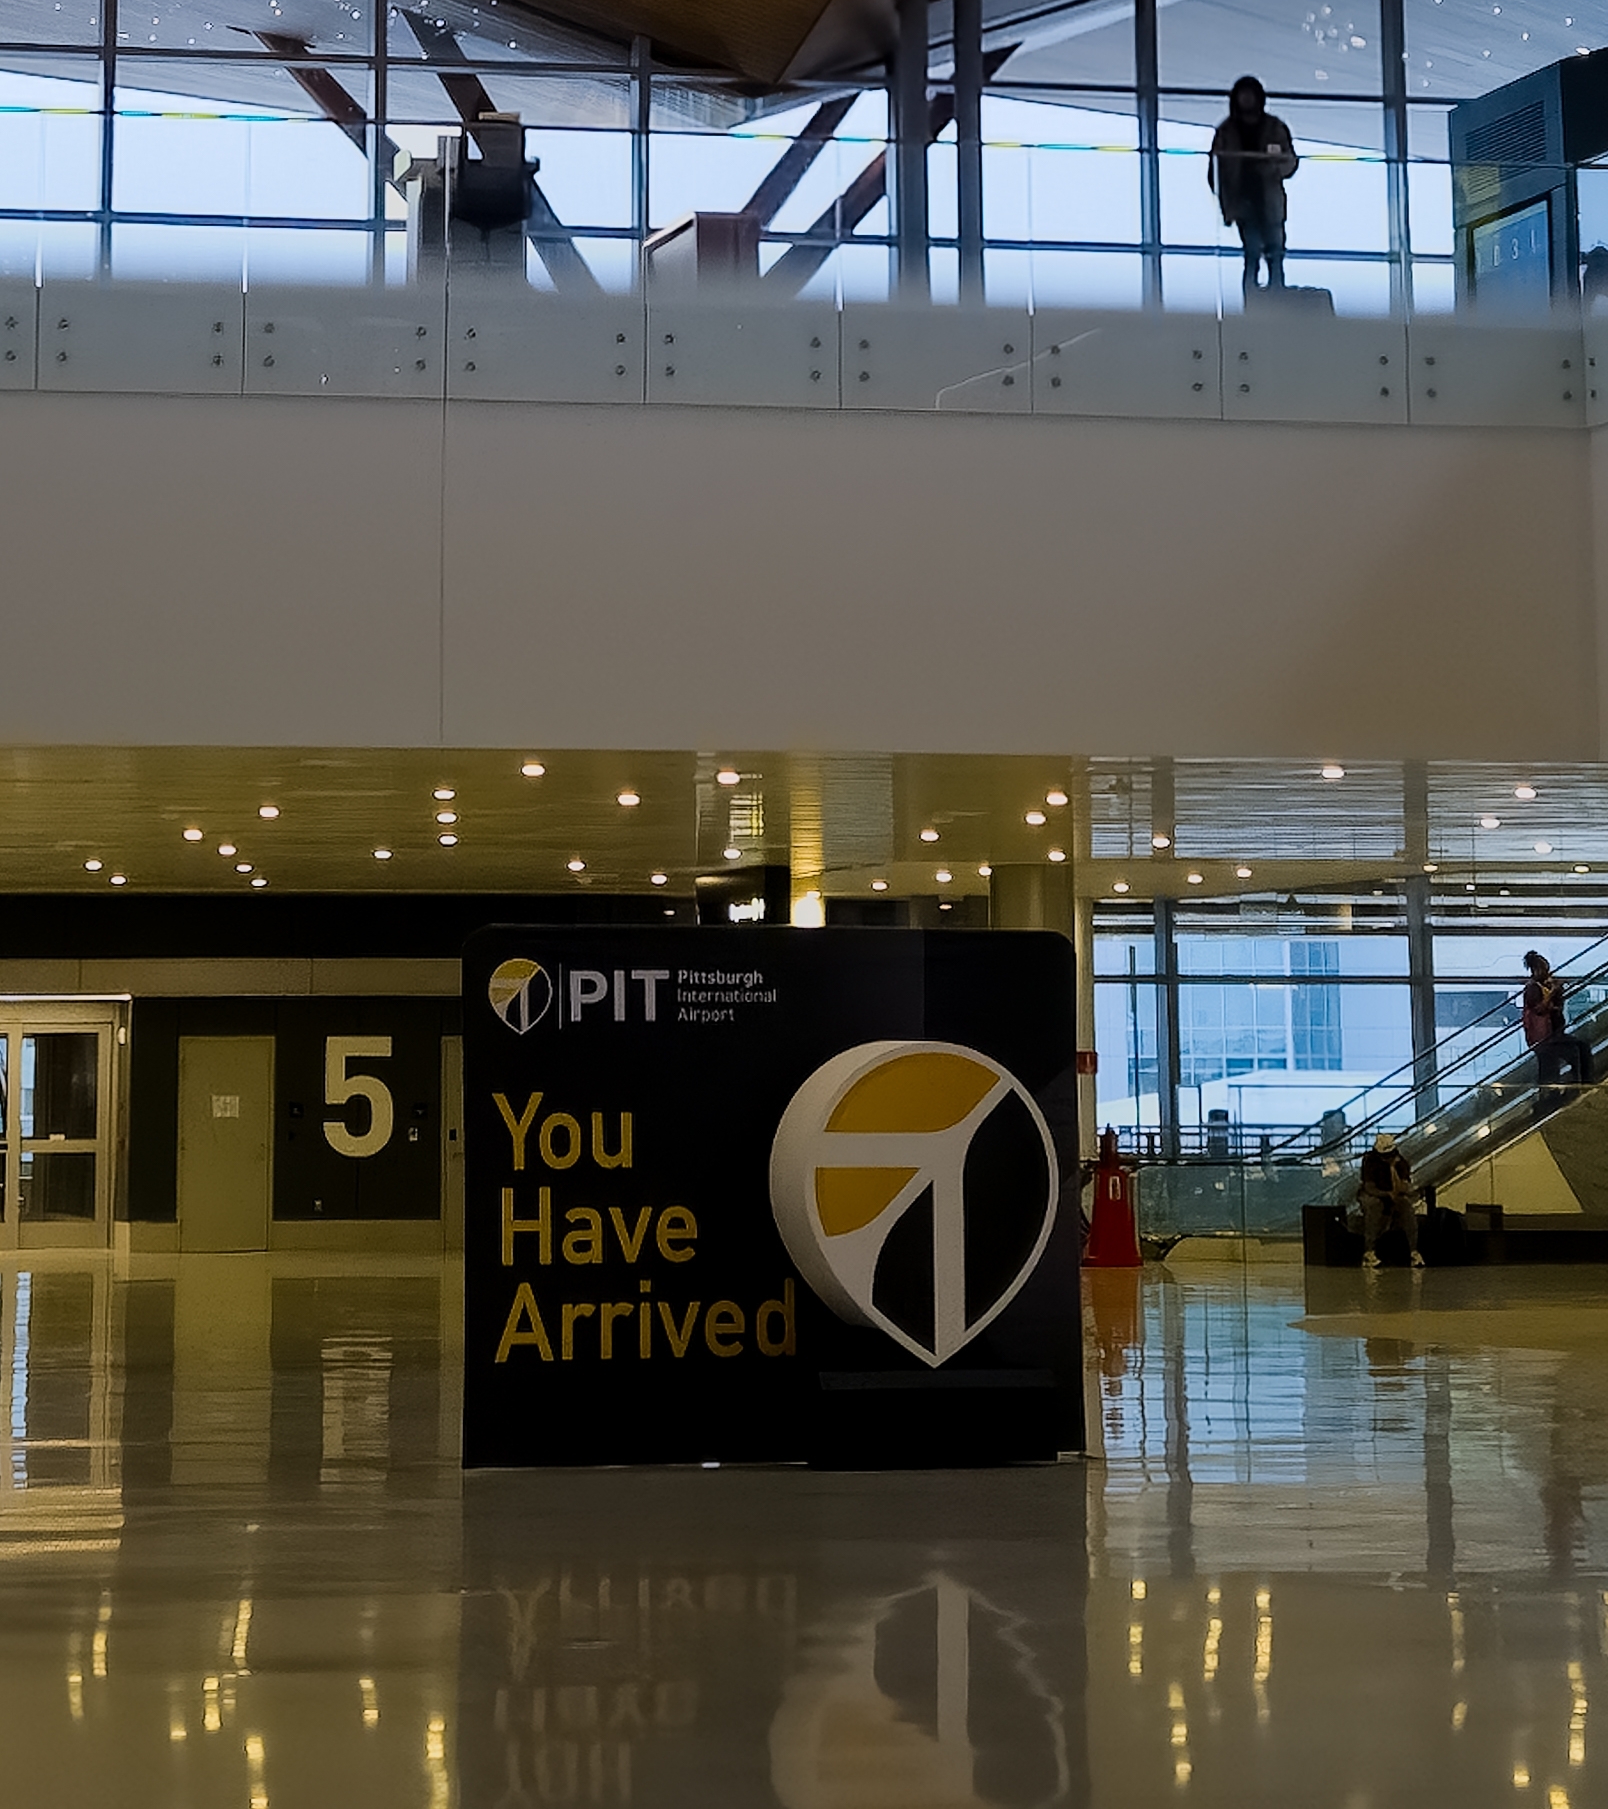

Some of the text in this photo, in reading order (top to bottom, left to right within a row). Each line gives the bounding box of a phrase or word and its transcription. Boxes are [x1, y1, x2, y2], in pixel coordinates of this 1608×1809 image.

[569, 969, 670, 1023] PIT
[677, 969, 764, 988] Pittsburgh
[677, 988, 777, 1004] International
[677, 1007, 735, 1024] Airport
[323, 1036, 393, 1158] 5
[492, 1091, 633, 1172] You
[500, 1186, 698, 1267] Have
[494, 1277, 797, 1363] Arrived
